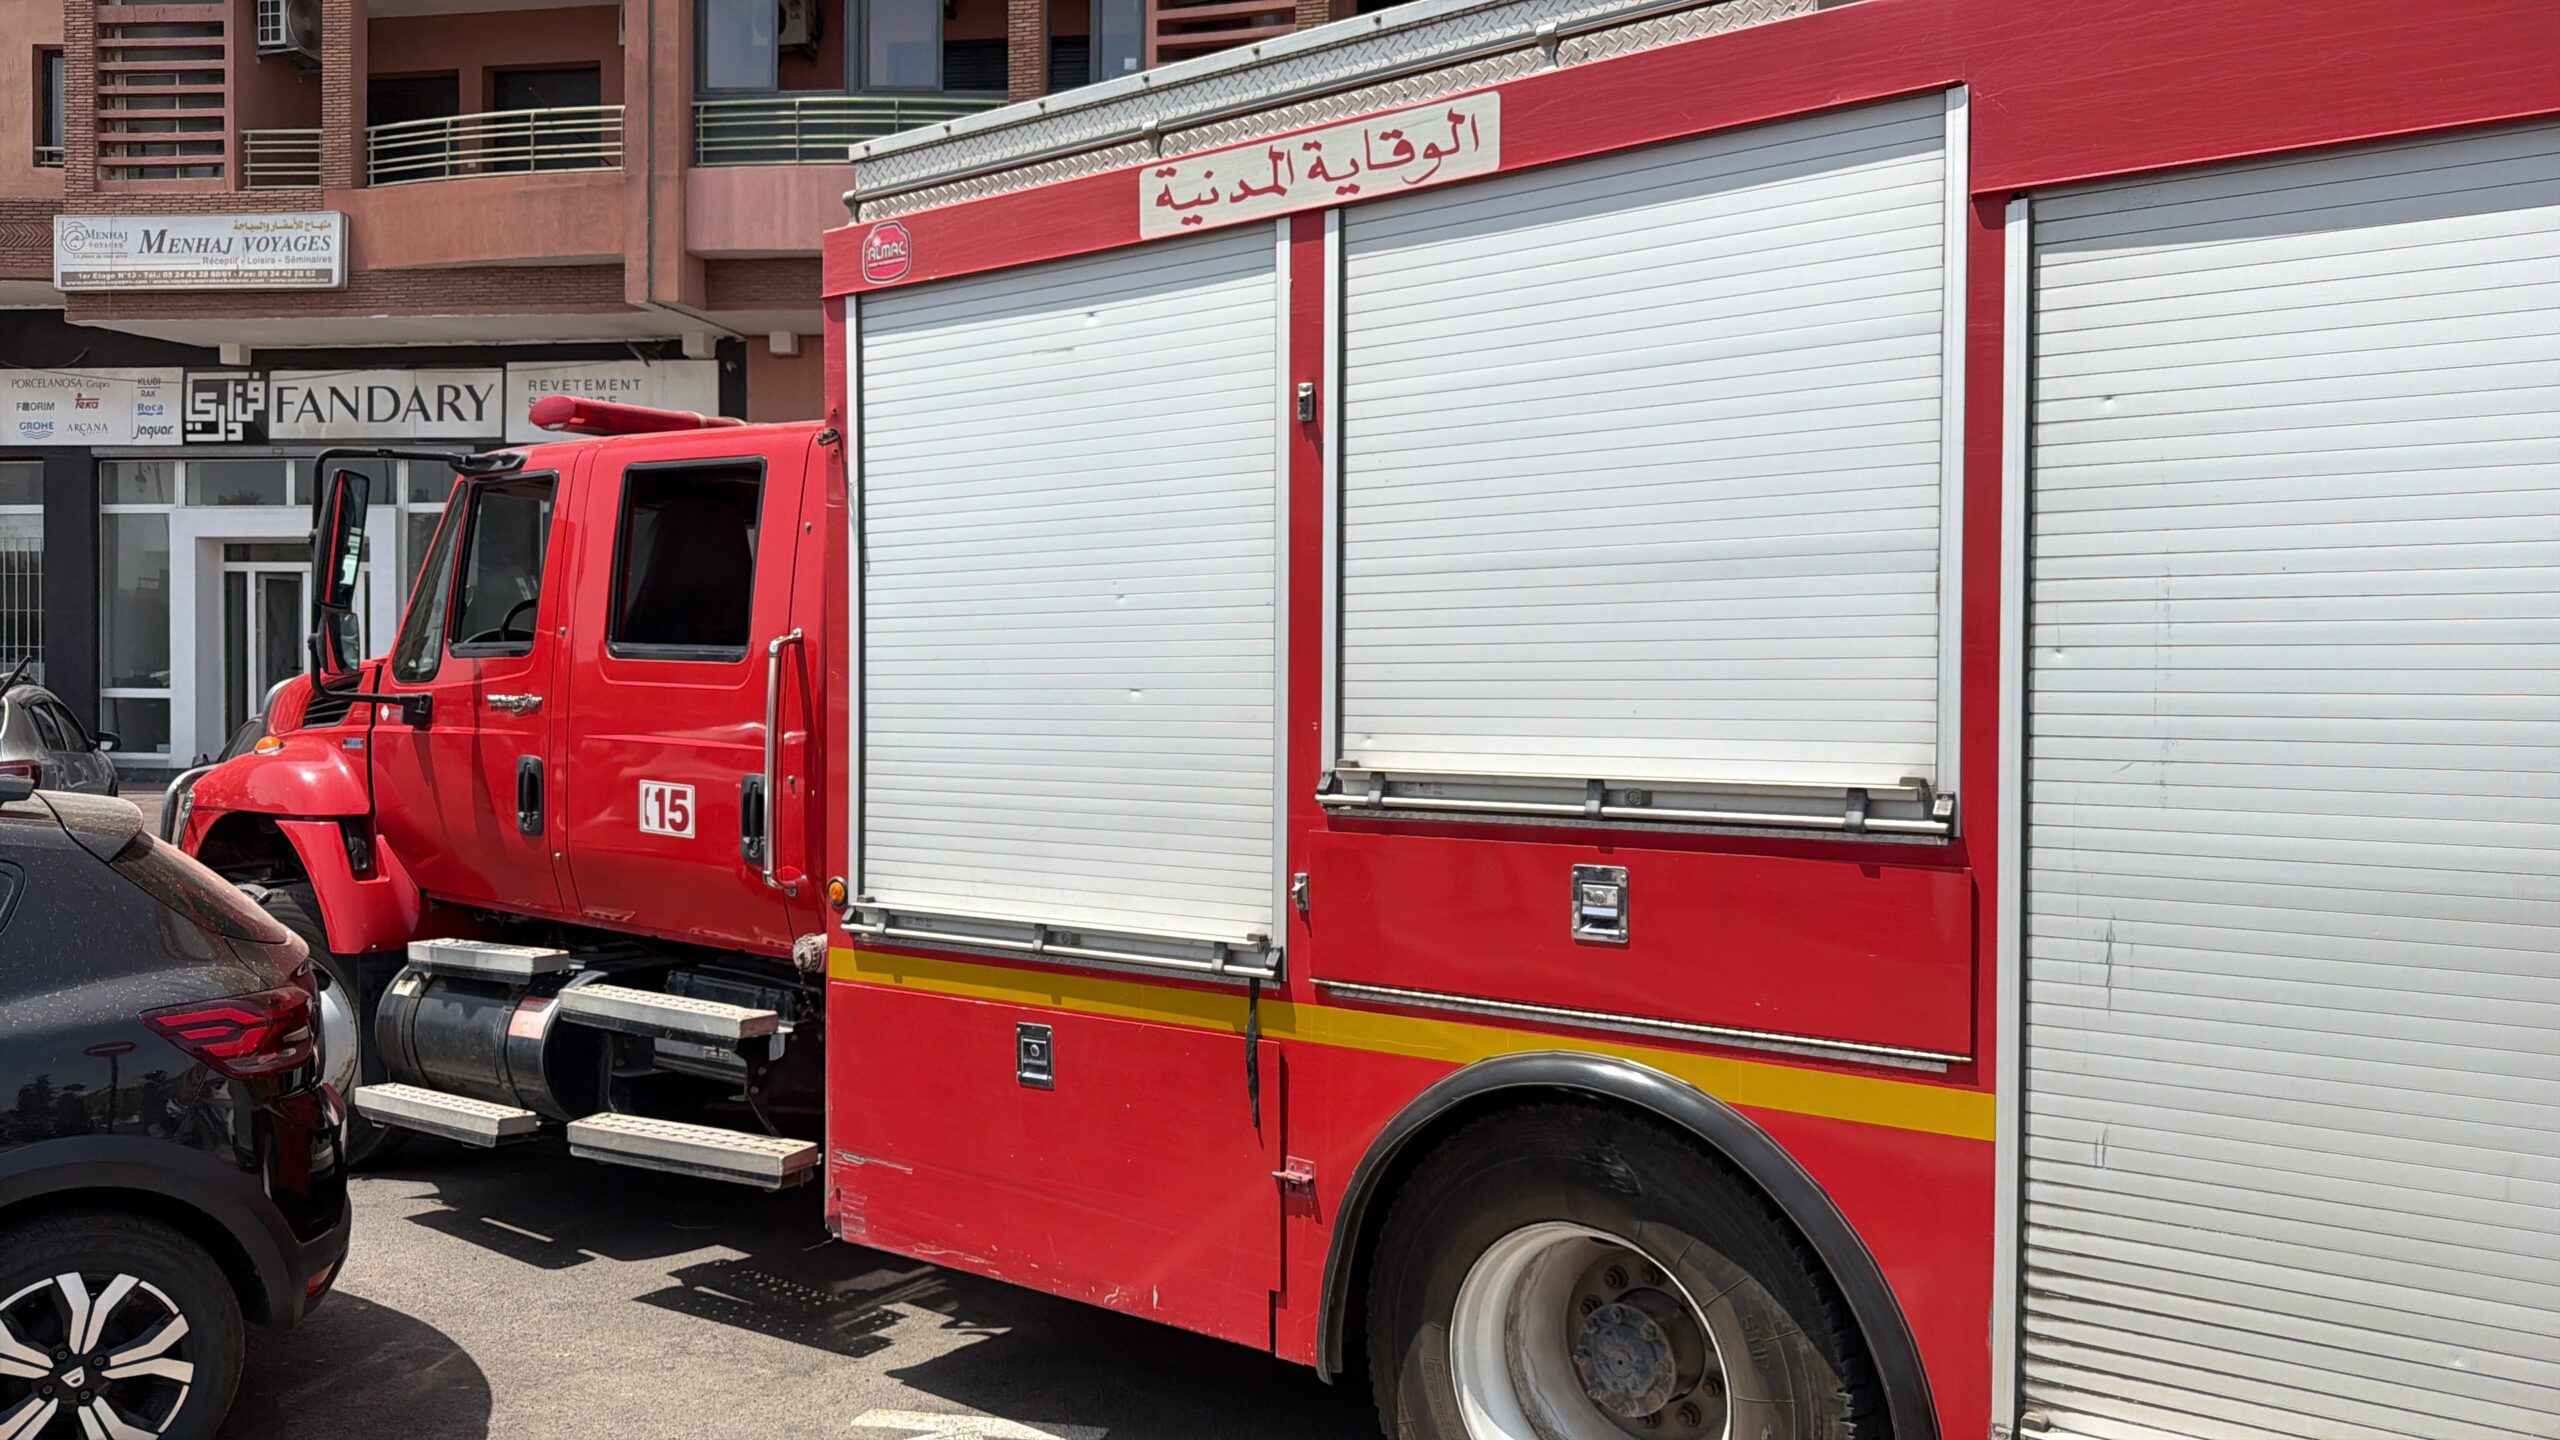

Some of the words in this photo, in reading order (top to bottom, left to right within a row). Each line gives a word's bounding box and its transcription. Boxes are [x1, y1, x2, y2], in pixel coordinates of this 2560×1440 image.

[1302, 108, 1480, 196] الوقاية
[1154, 144, 1295, 226] المدنية
[85, 229, 128, 243] MENHAJ
[137, 229, 234, 255] MENHAJ
[242, 235, 332, 254] VOYAGES
[868, 241, 906, 261] ALMAC
[202, 256, 239, 266] Réceptif
[247, 256, 276, 265] Loisirs
[284, 255, 333, 264] Séminaires
[11, 378, 82, 389] PORCELANOSA
[528, 379, 642, 391] REVETEMENT
[141, 389, 156, 397] RAK
[137, 403, 164, 412] Roca
[276, 384, 494, 423] FANDARY
[19, 421, 54, 430] GROHE
[67, 423, 108, 436] ARCANA
[655, 788, 690, 832] 15
